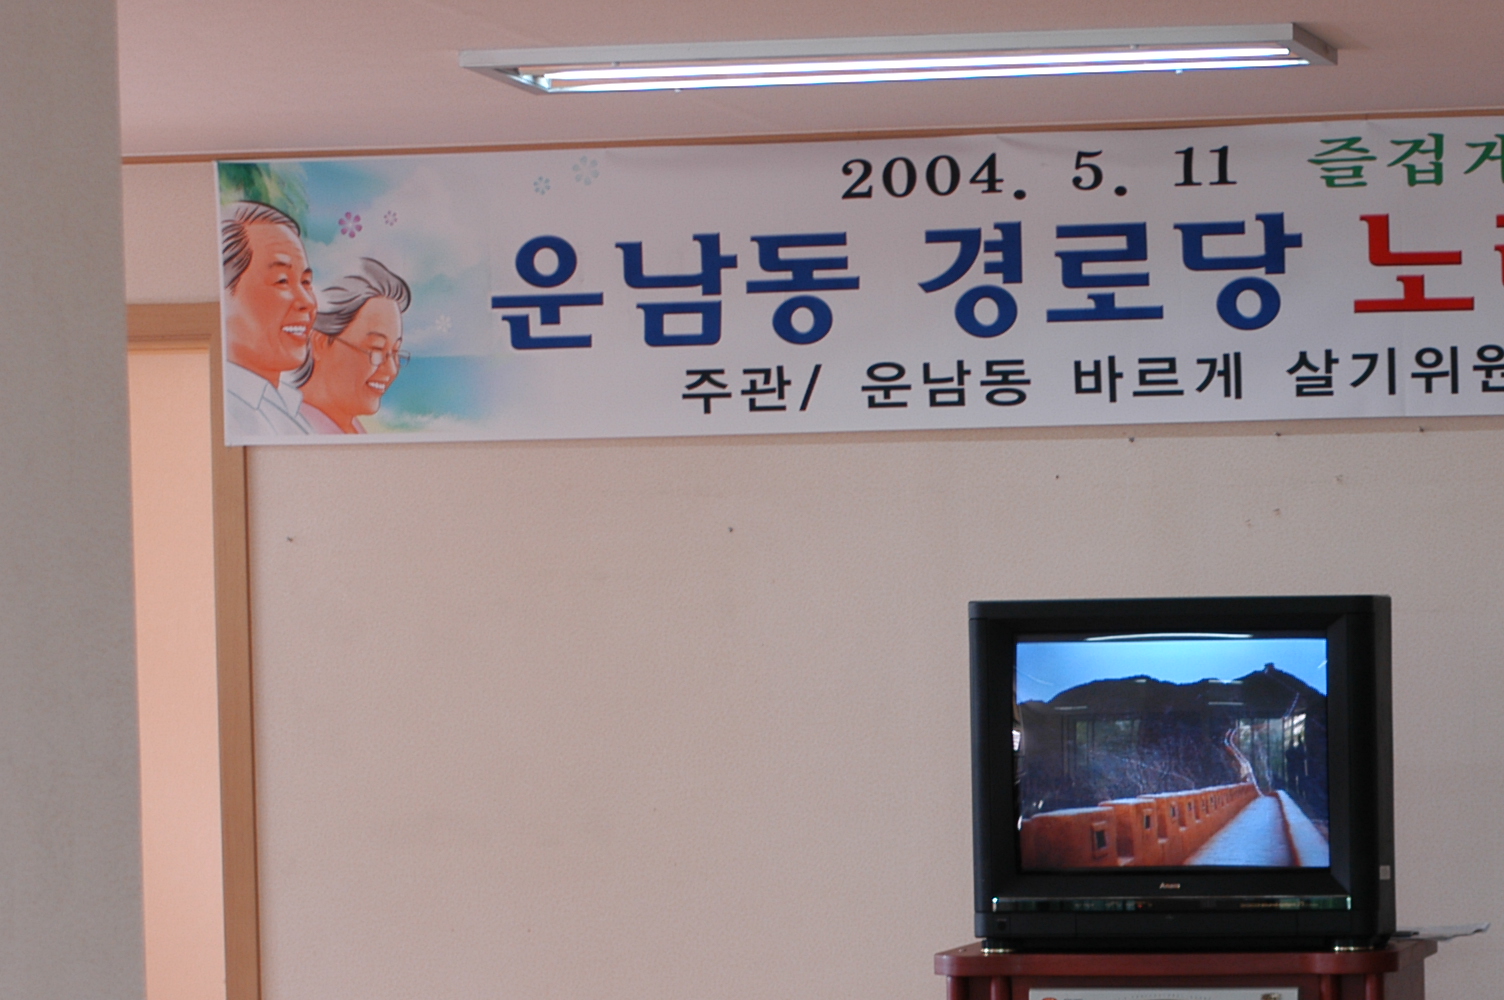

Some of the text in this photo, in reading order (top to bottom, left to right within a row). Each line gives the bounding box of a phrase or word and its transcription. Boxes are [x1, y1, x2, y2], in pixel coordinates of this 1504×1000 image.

[842, 145, 1238, 201] 2004. 5. 11
[491, 231, 861, 351] 운남동
[917, 212, 1303, 339] 경로당
[681, 364, 823, 415] 주관/
[860, 359, 1032, 409] 운남동
[1073, 352, 1243, 404] 바르게
